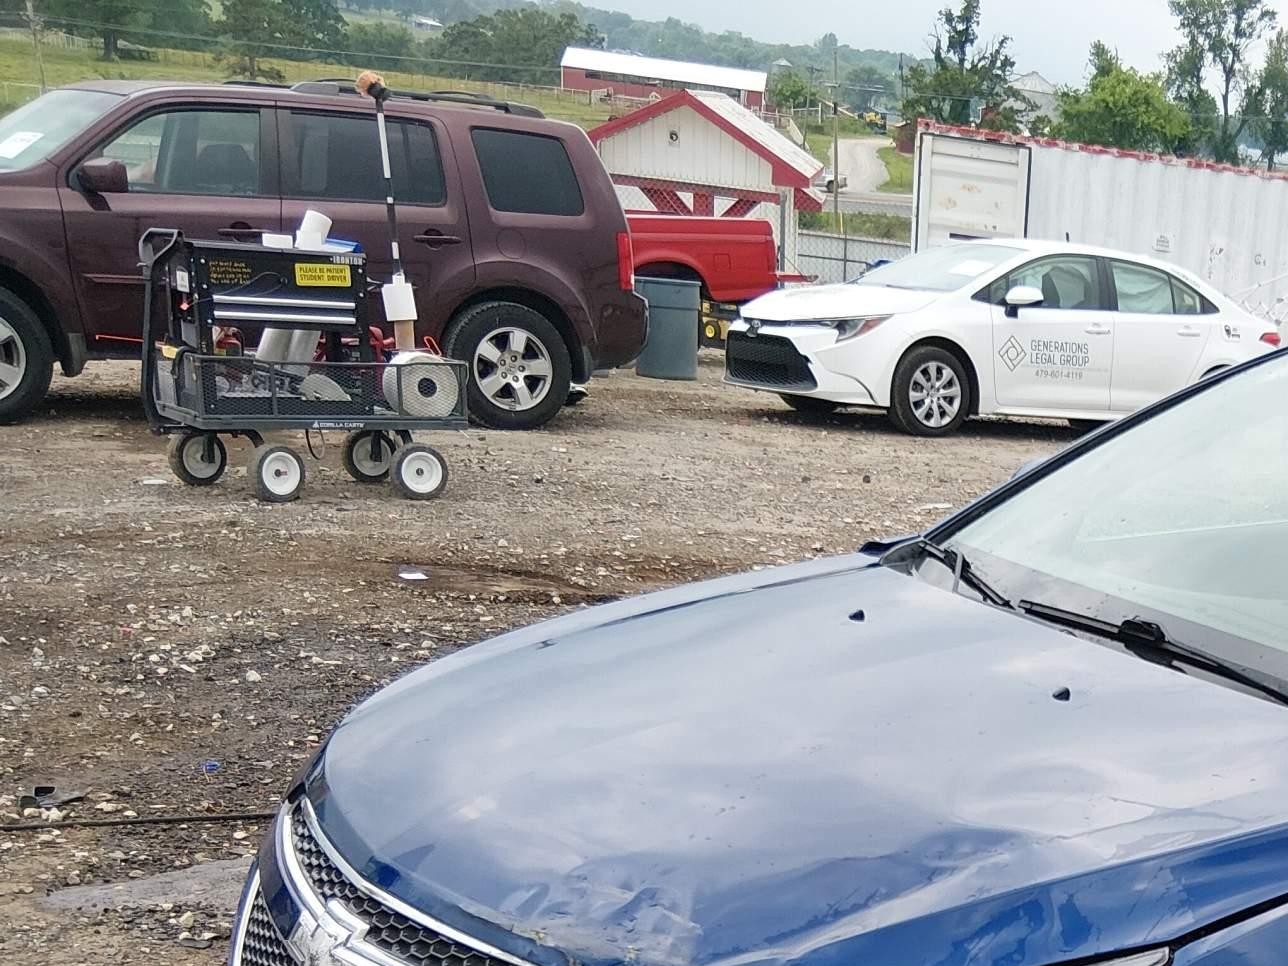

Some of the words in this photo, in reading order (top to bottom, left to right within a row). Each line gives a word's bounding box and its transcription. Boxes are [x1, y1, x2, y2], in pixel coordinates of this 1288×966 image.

[326, 267, 346, 275] PATIENT
[299, 274, 325, 282] STUDENT
[326, 275, 347, 283] DRIVER
[1030, 339, 1089, 355] GENERATIONS
[1030, 352, 1057, 365] LEGAL
[1060, 354, 1090, 367] GROUP
